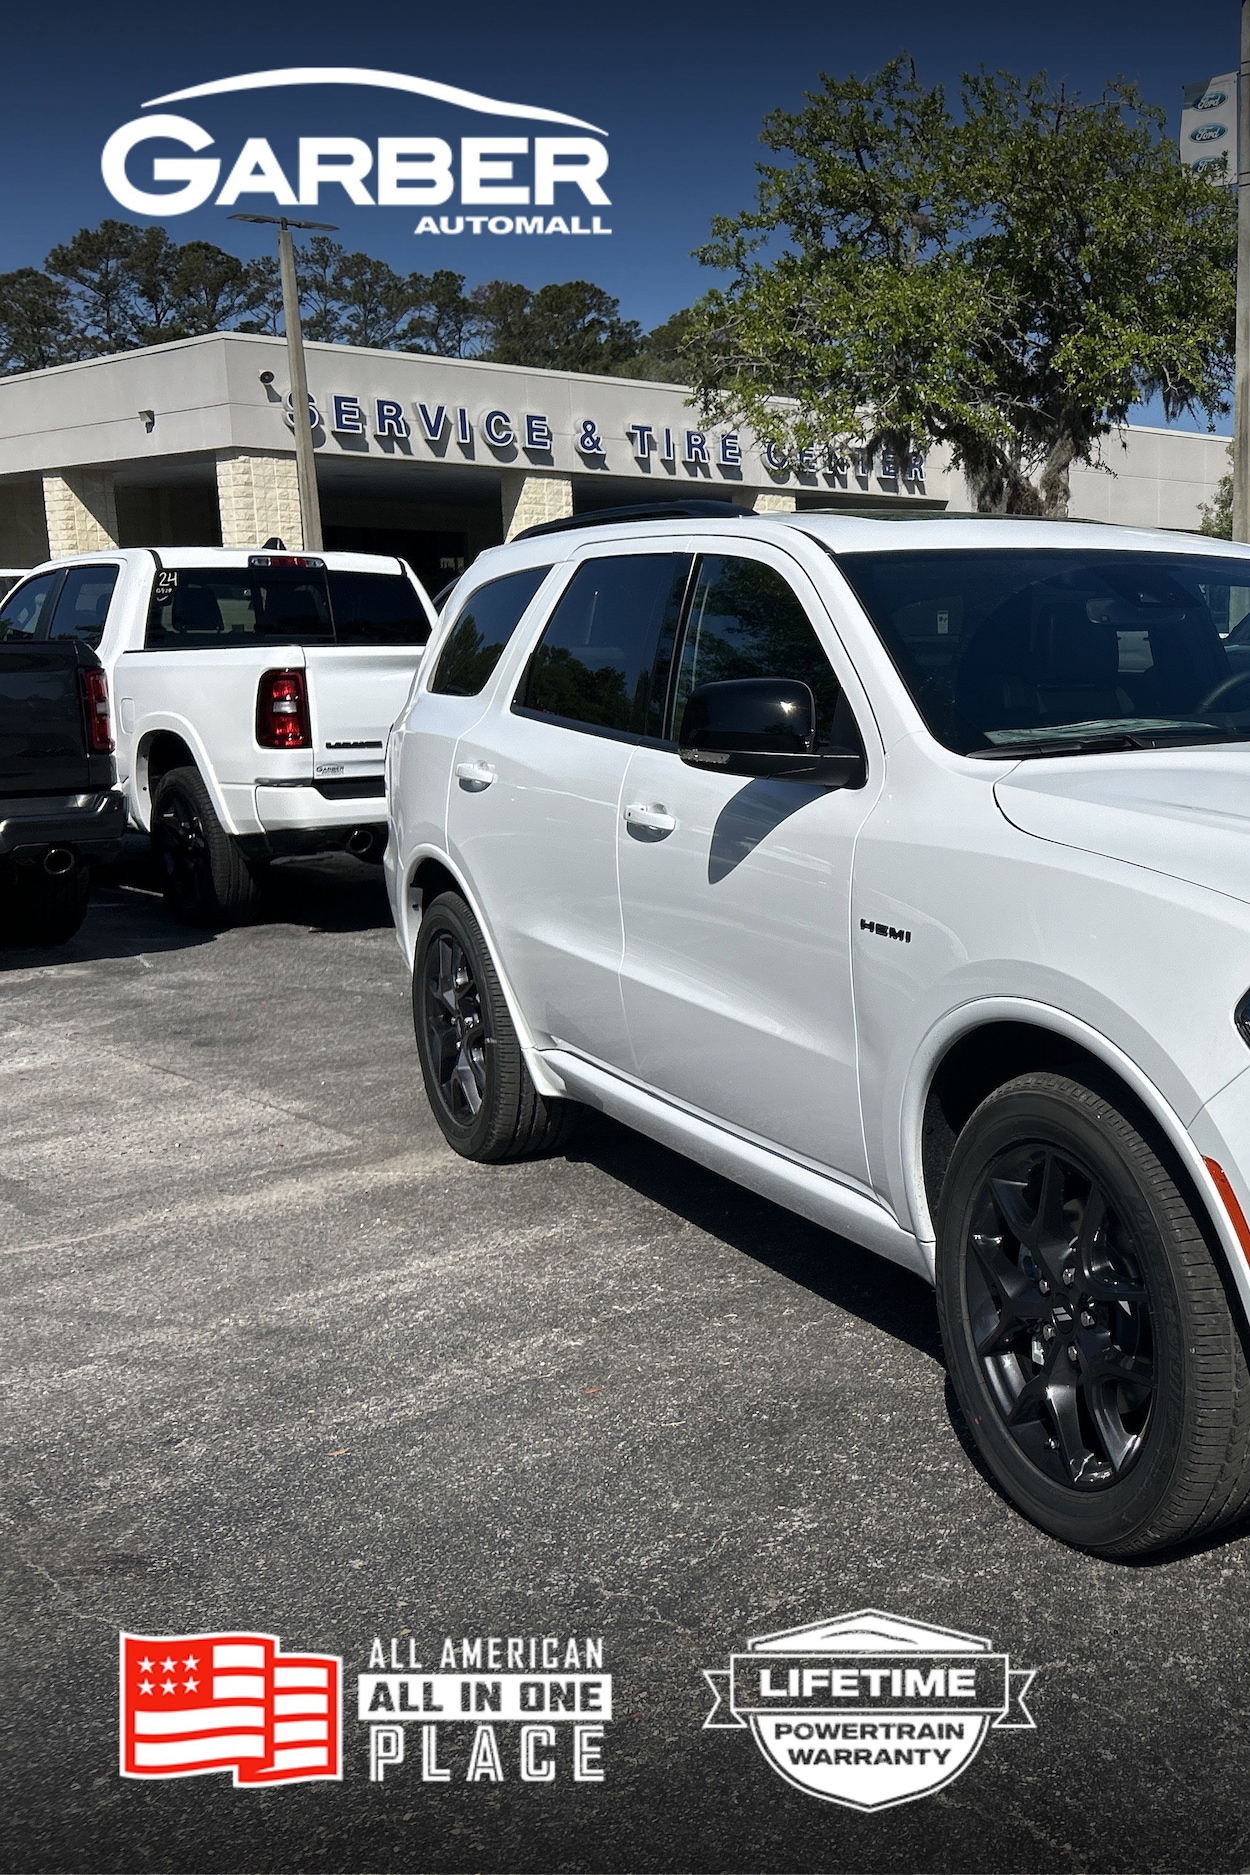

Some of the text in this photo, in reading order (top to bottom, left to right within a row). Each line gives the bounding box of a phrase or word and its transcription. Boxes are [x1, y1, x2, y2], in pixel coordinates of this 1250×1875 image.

[1198, 94, 1222, 108] Ford
[1195, 126, 1221, 141] Ford
[574, 418, 605, 455] &
[629, 423, 742, 465] TIRE
[159, 571, 178, 587] 24
[860, 918, 912, 944] HEMI
